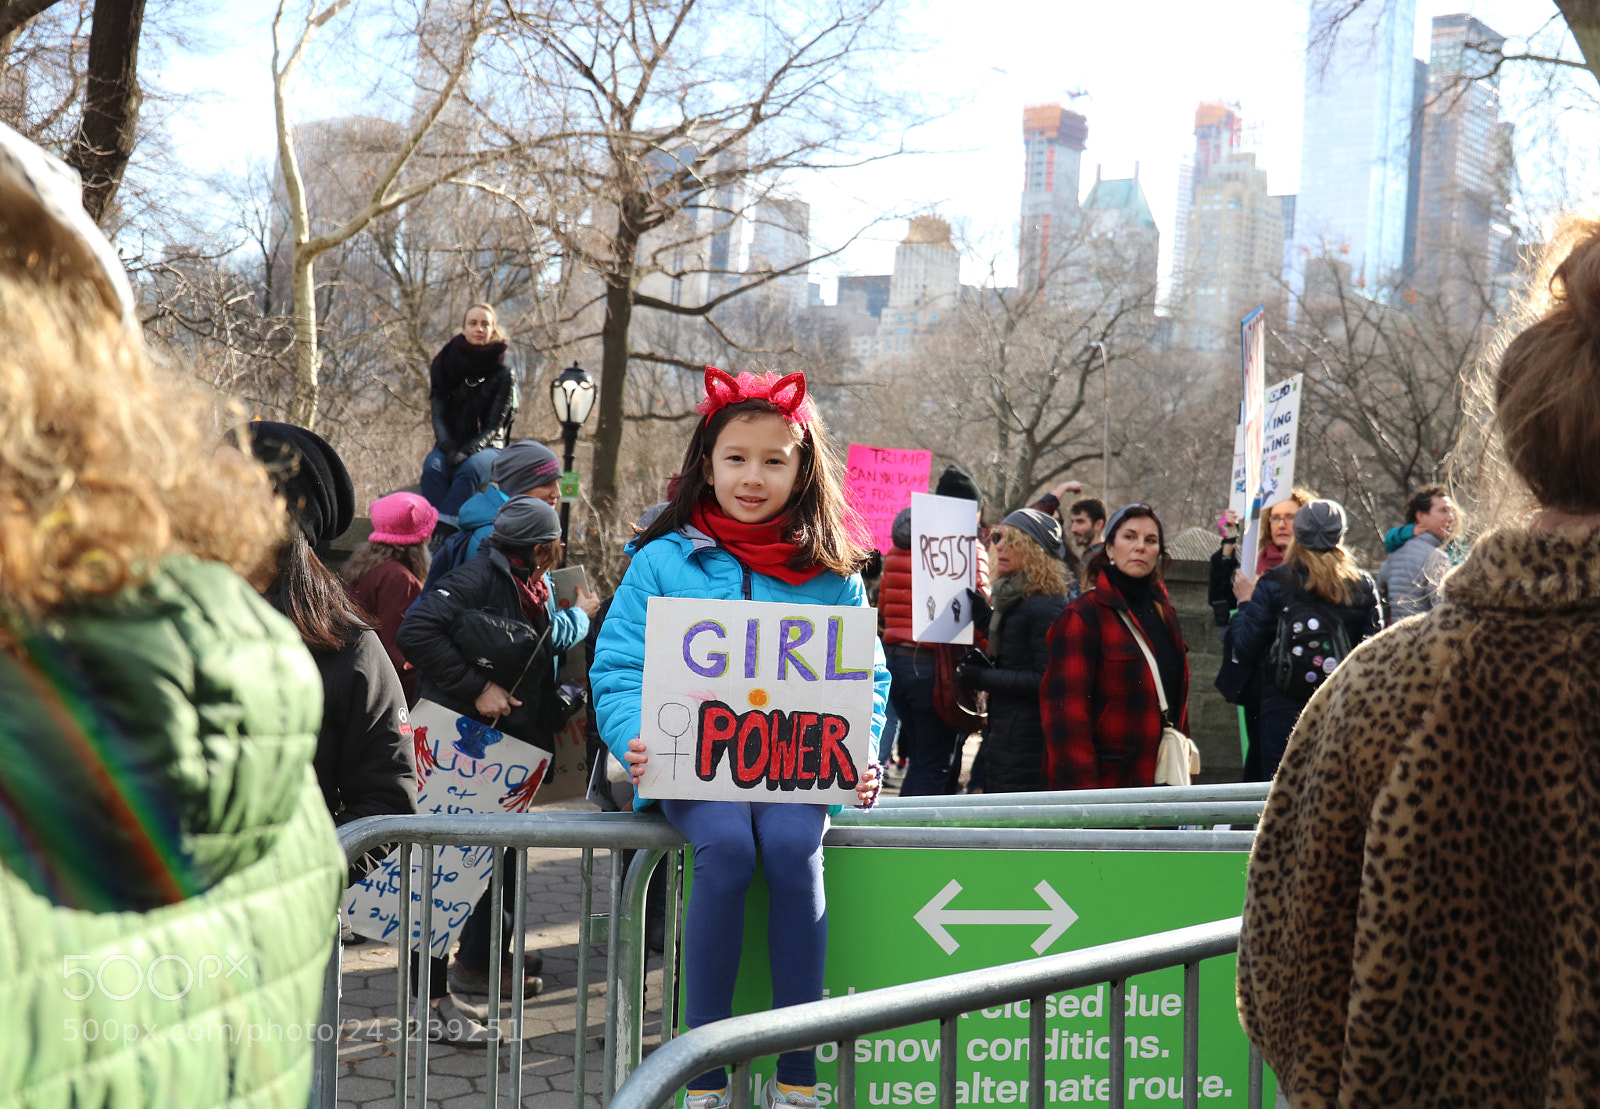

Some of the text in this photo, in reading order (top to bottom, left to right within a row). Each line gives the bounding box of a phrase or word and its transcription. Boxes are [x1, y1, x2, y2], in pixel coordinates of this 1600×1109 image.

[850, 466, 876, 482] CAN
[871, 488, 896, 501] FOR
[919, 534, 977, 588] RESIST
[682, 615, 872, 682] GIRL
[695, 699, 859, 792] POWER
[447, 785, 478, 801] to
[432, 865, 459, 891] of
[369, 906, 400, 940] Are
[1125, 985, 1182, 1017] due
[855, 1037, 940, 1063] snow
[966, 1028, 1170, 1061] conditions.
[869, 1080, 937, 1106] use
